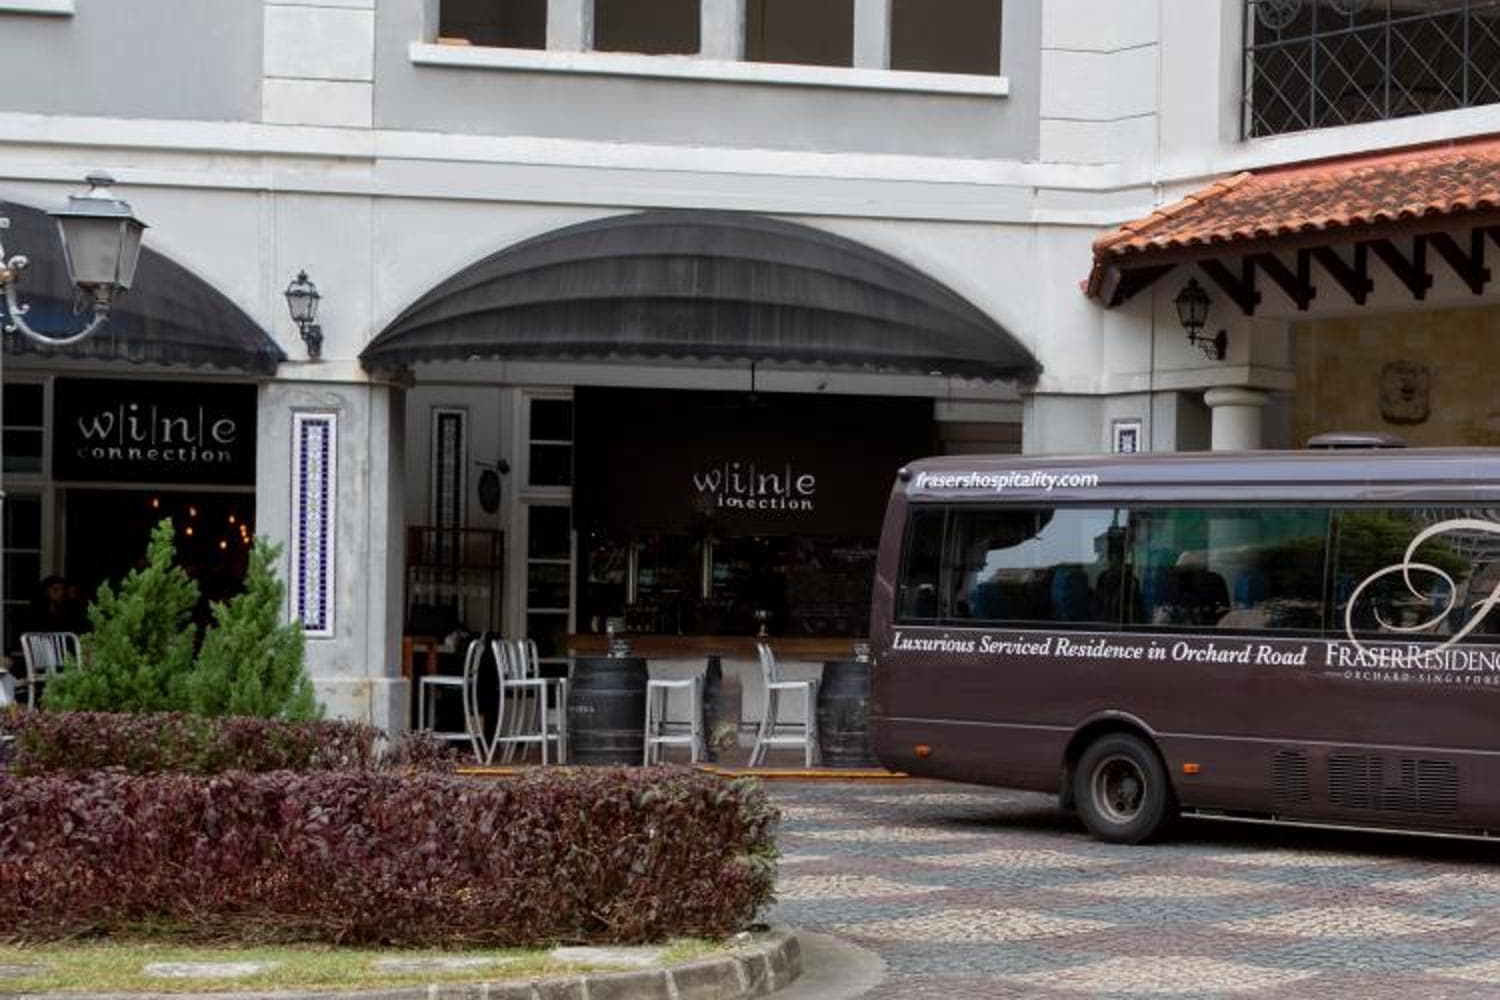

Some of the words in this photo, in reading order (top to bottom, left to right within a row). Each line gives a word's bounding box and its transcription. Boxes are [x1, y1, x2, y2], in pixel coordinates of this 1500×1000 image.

[77, 445, 232, 463] connection
[915, 471, 1099, 491] frasershospitality.com
[892, 632, 975, 653] Luxurious
[980, 636, 1050, 656] Serviced
[1054, 639, 1144, 660] Residence
[1148, 641, 1166, 660] in
[1171, 642, 1252, 664] Orchard
[1255, 645, 1308, 666] Road
